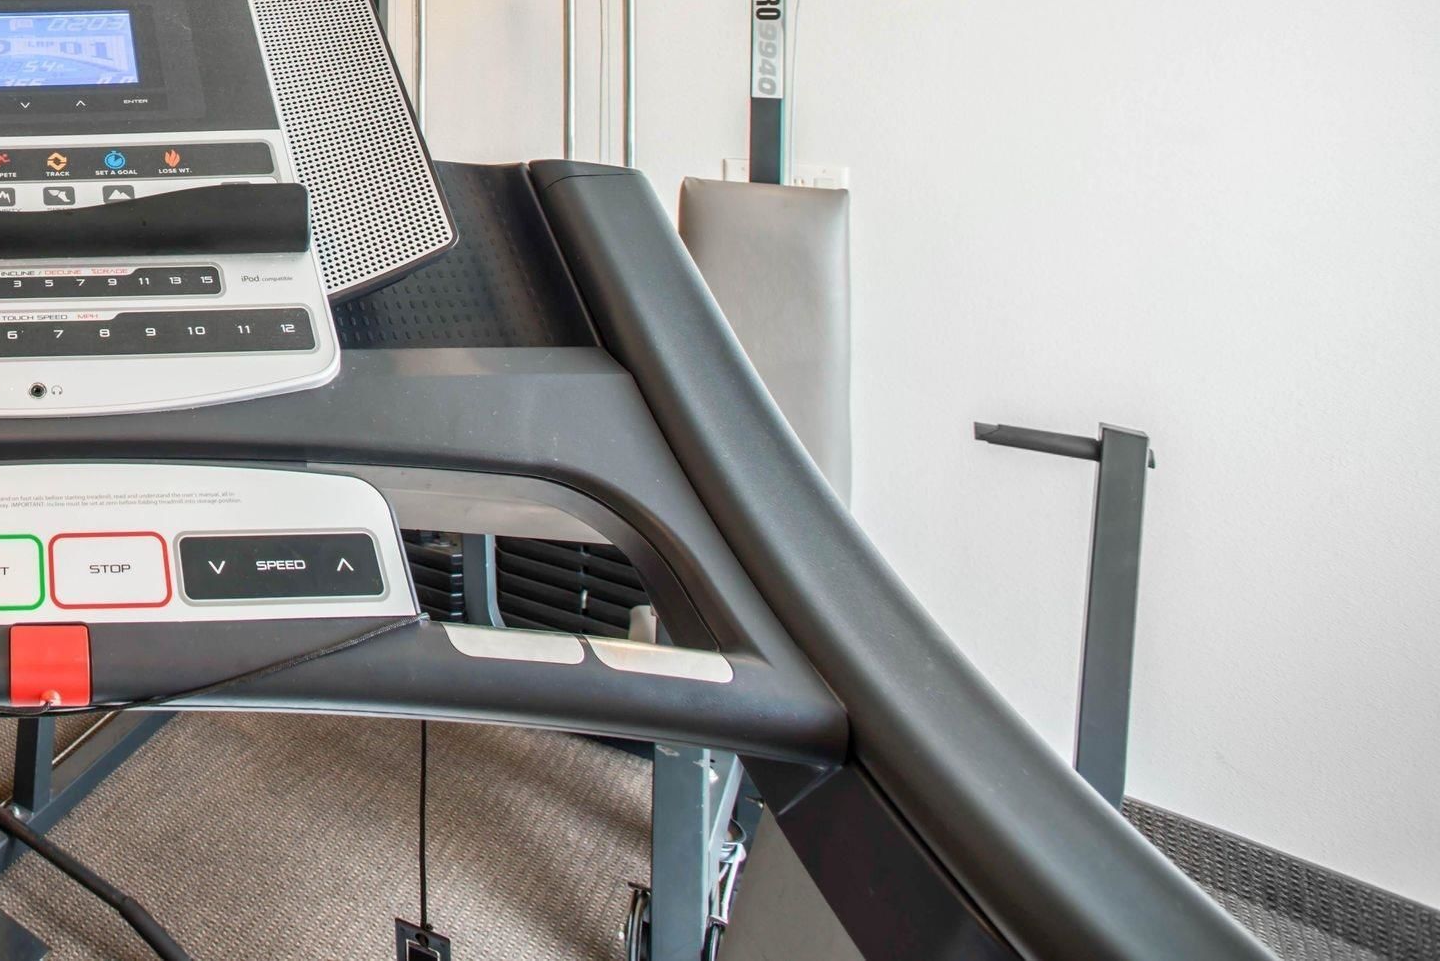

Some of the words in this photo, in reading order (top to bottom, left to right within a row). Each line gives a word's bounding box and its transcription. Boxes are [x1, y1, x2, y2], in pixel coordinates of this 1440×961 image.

[756, 22, 777, 97] 9940
[13, 280, 22, 288] 3
[44, 280, 54, 288] 5
[76, 279, 86, 287] 7
[108, 278, 117, 286] 9
[138, 277, 150, 286] 11
[169, 276, 182, 285] 13
[200, 276, 213, 284] 15
[241, 274, 260, 283] iPod
[7, 331, 18, 340] 6
[54, 330, 64, 338] 7
[100, 329, 110, 338] 8
[145, 328, 156, 337] 9
[188, 326, 206, 335] 10
[238, 325, 251, 334] 11
[280, 324, 295, 333] 12
[89, 564, 131, 574] STOP
[256, 560, 306, 571] SPEED
